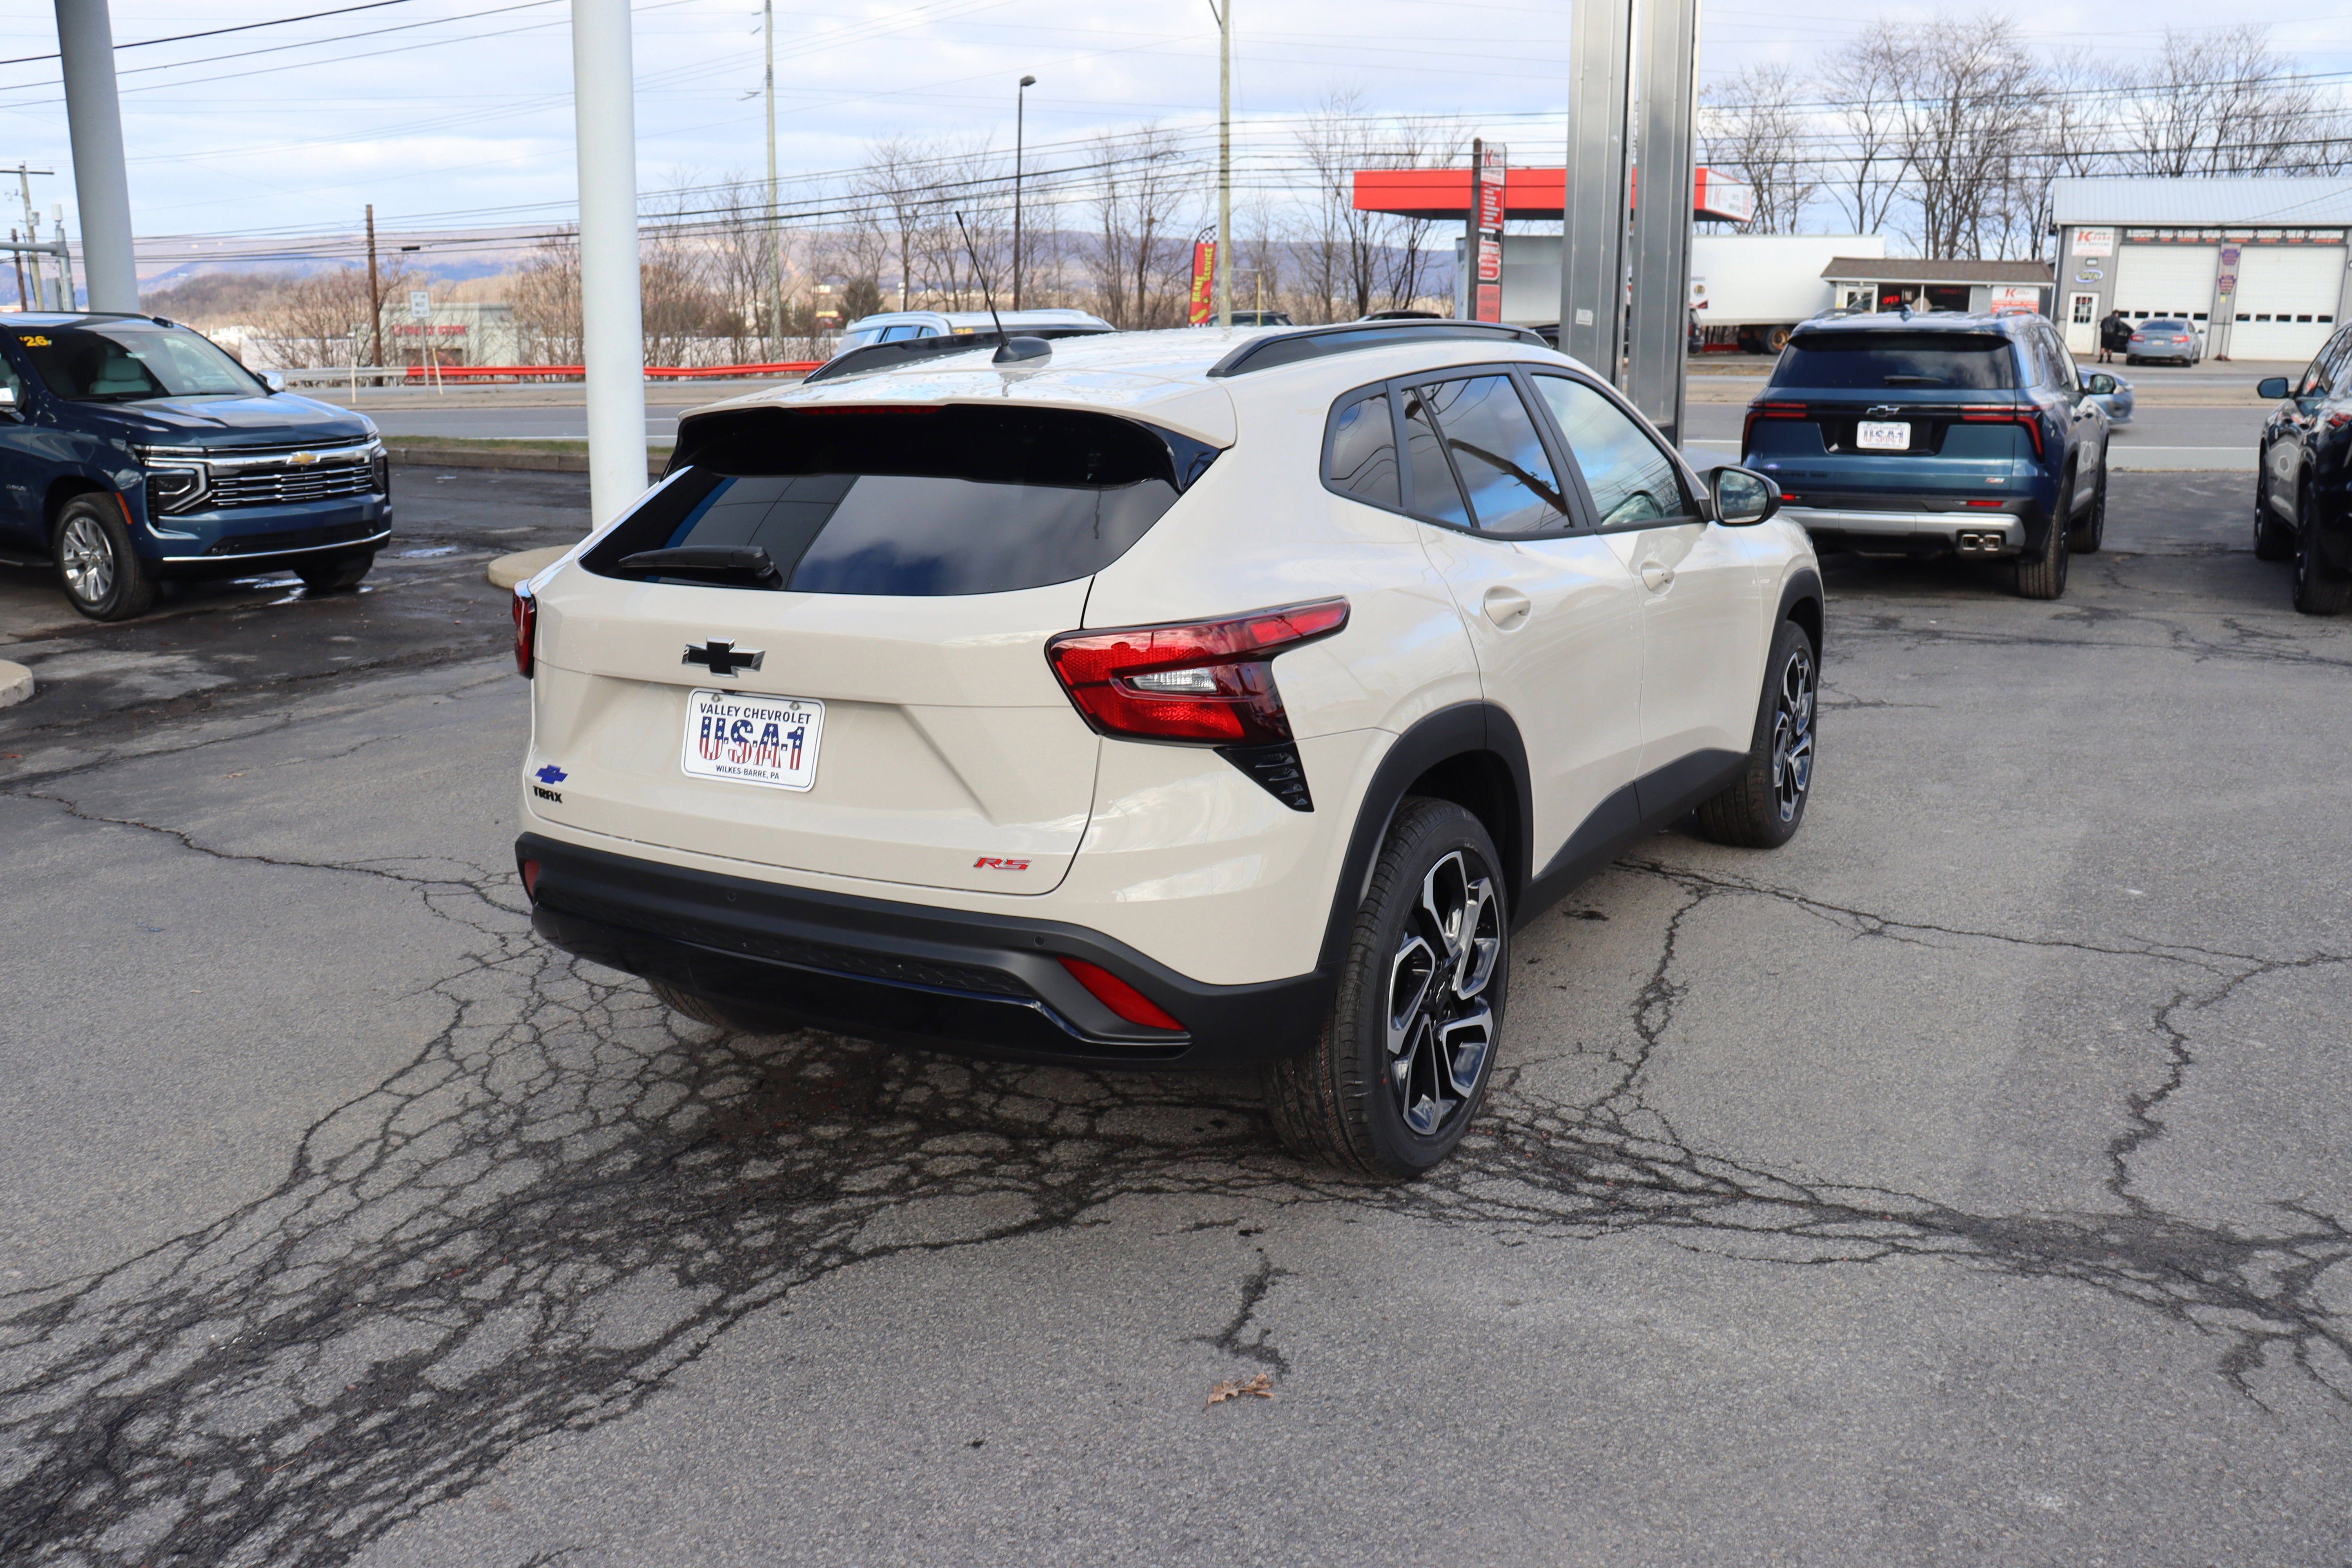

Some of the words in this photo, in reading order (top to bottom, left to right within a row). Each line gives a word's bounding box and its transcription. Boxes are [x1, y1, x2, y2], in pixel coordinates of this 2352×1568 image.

[2079, 271, 2100, 281] OPEN
[1882, 295, 1900, 305] OPEN
[19, 335, 48, 347] '26
[700, 703, 741, 717] VALLEY
[744, 707, 812, 724] CHEVROLET
[716, 764, 769, 780] WILKES-BARRE,
[532, 785, 563, 804] TRAX
[973, 856, 1033, 871] RS
